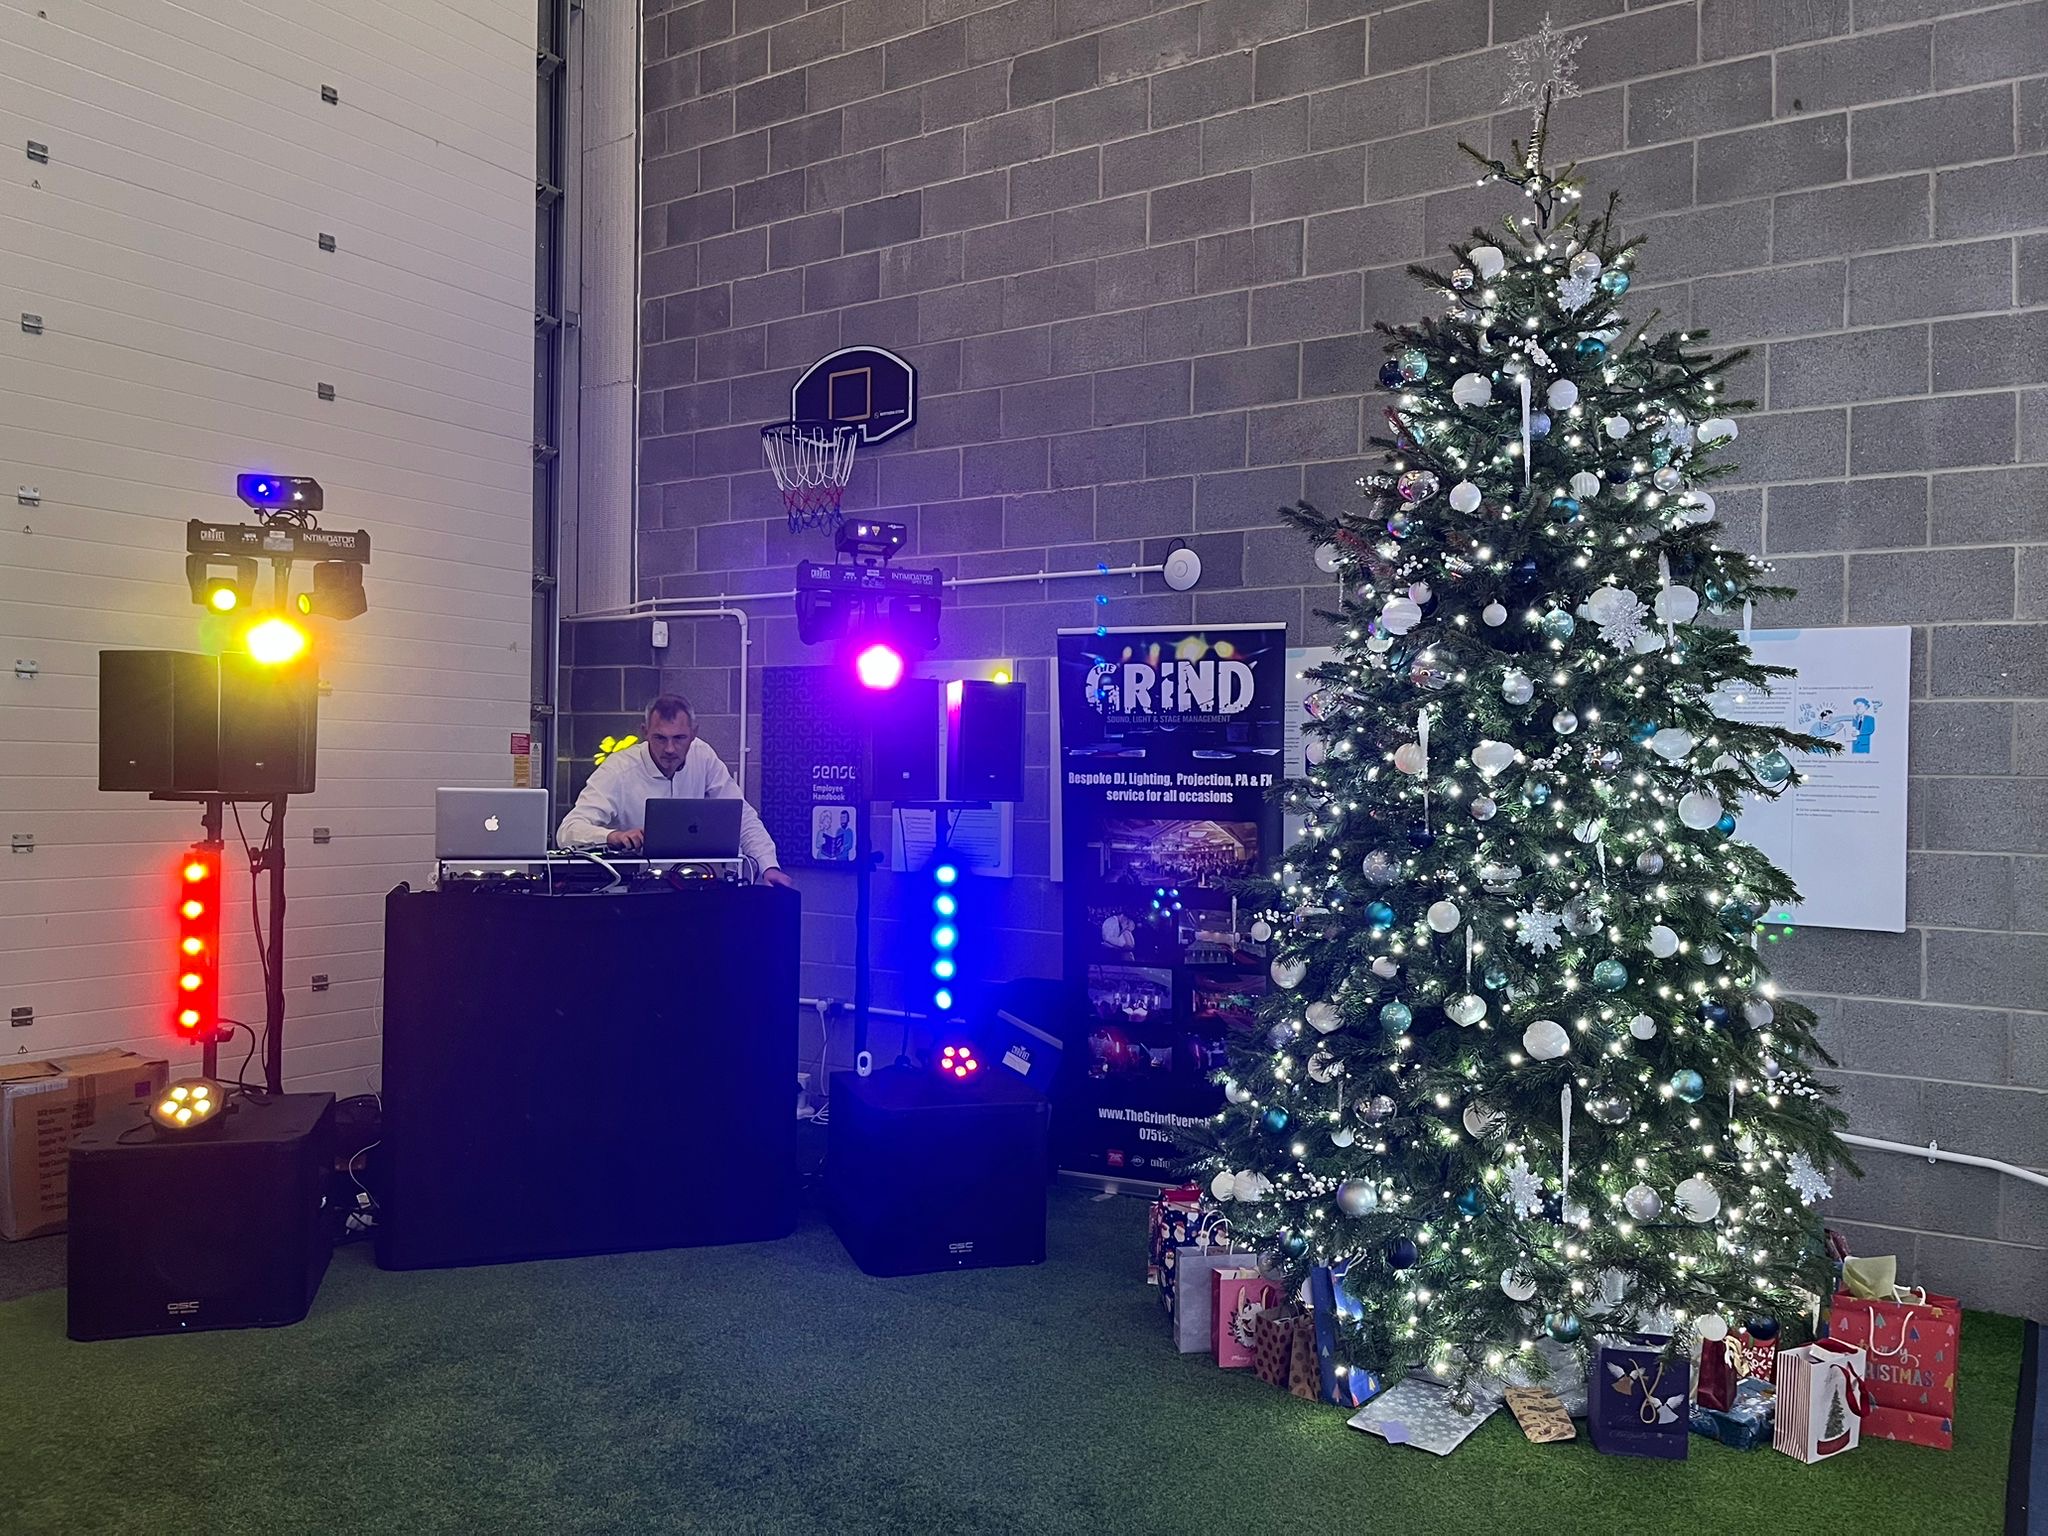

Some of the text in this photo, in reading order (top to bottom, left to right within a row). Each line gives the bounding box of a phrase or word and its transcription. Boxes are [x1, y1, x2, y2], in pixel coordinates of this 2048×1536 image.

[303, 533, 355, 543] INTIMIDATOR
[1133, 715, 1151, 723] LIGHT
[1160, 715, 1181, 723] STAGE
[1183, 715, 1231, 723] MANAGEMENT
[1068, 772, 1273, 787] Bespoke DJ, Lighting, Projection, PA & FX
[812, 784, 844, 794] Employee
[812, 792, 846, 801] Handbook
[1106, 789, 1233, 803] service for all occasions
